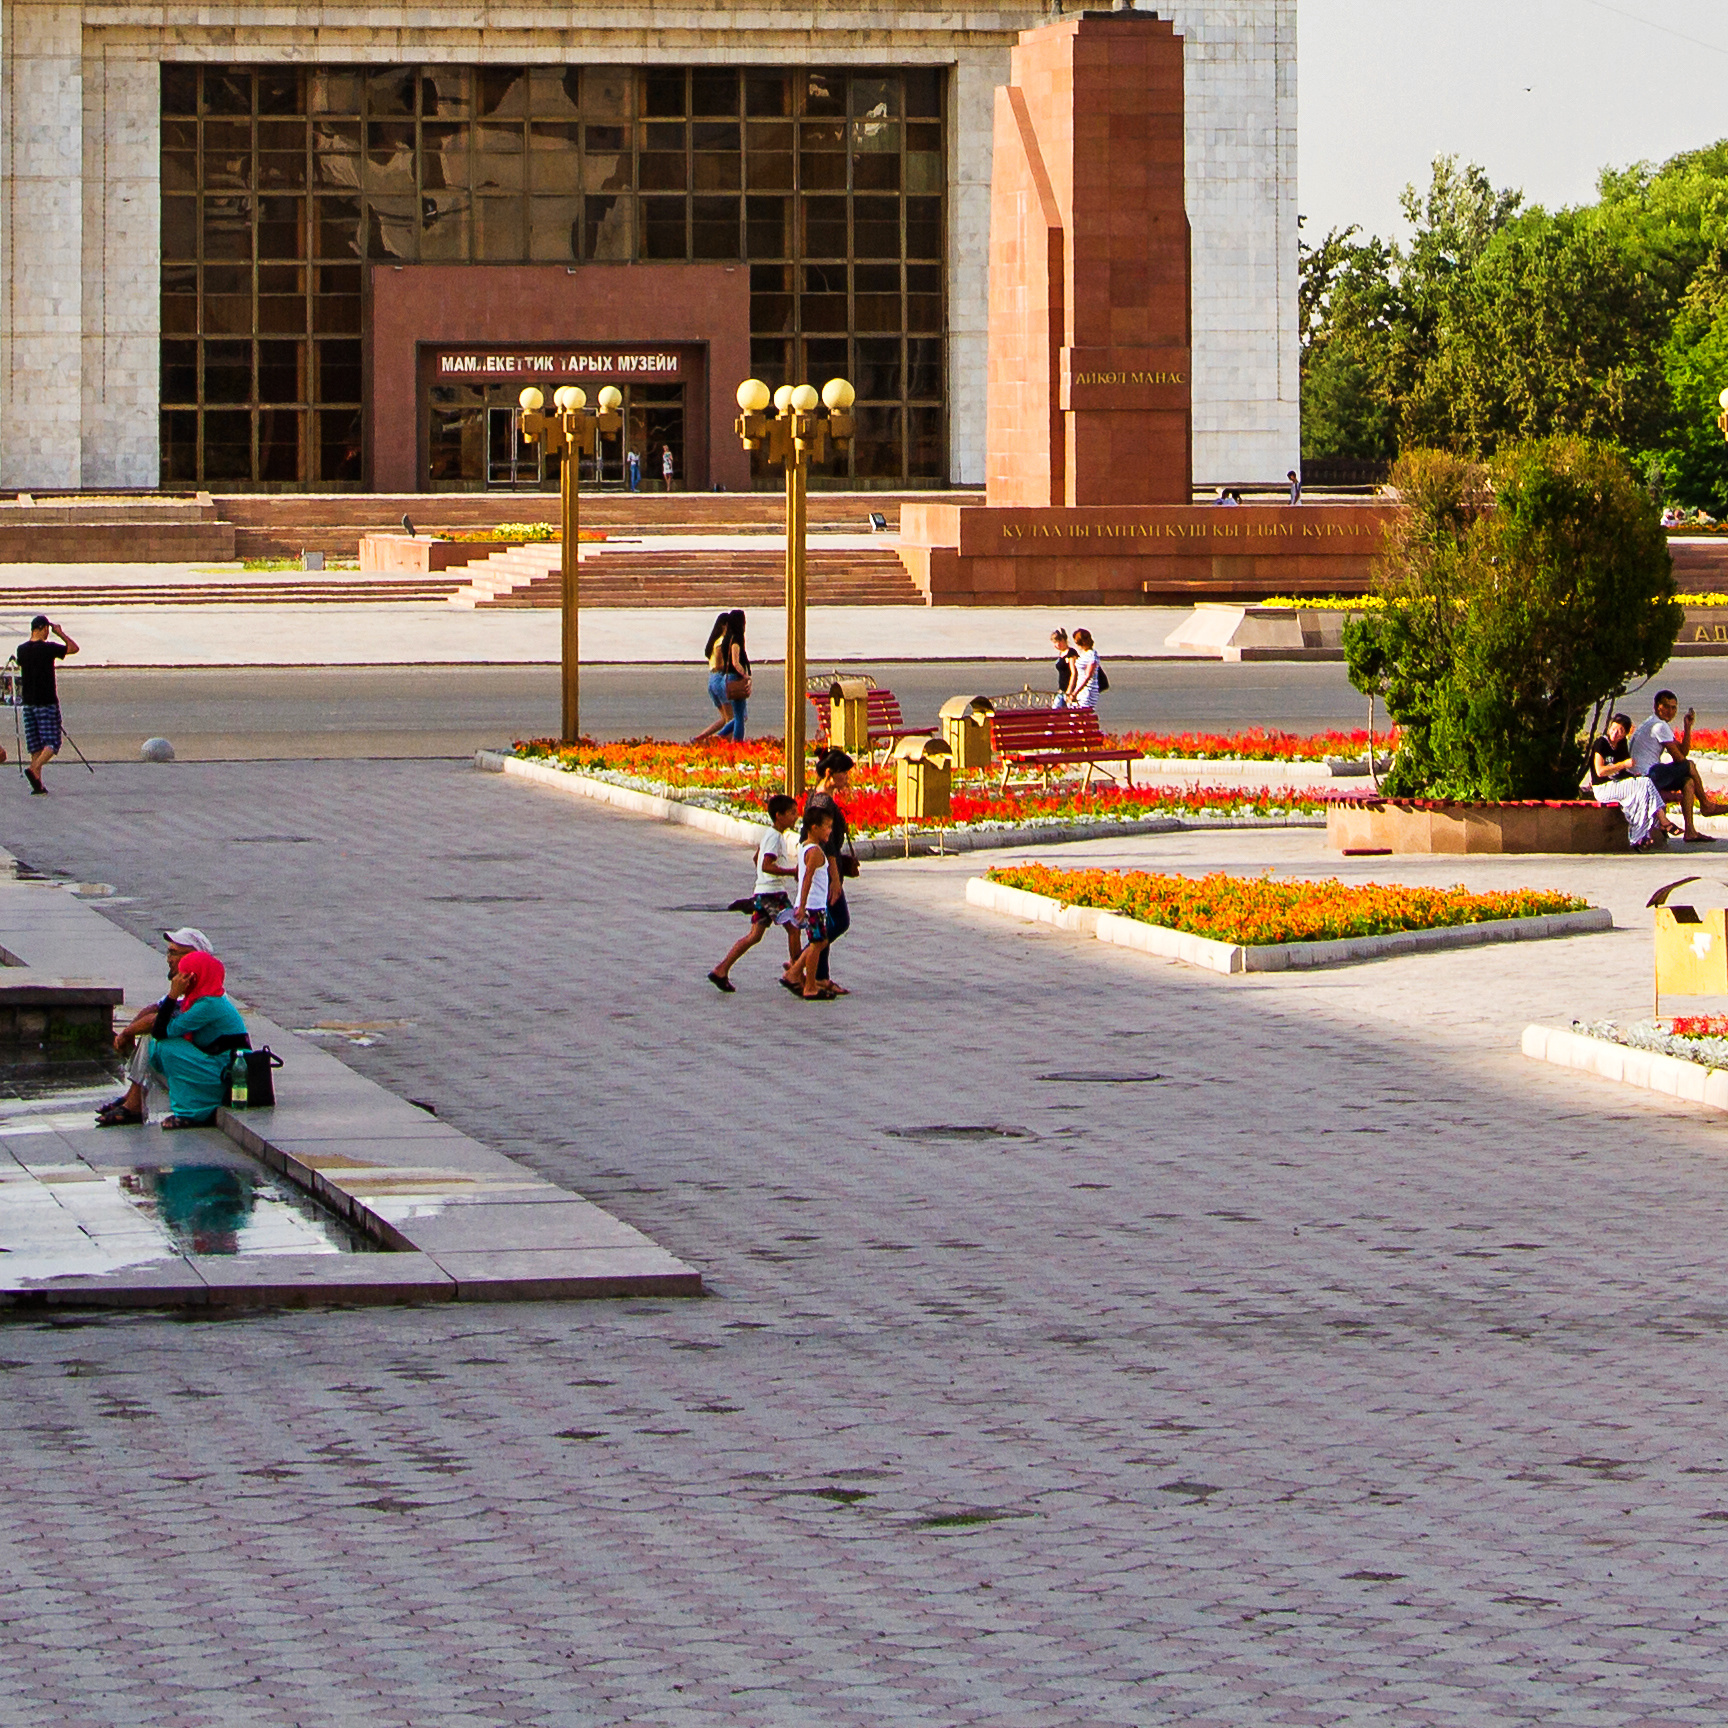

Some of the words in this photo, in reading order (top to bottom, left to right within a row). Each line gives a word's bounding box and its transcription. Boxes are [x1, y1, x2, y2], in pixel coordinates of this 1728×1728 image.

[441, 356, 554, 372] МАМЛЕКЕТТИК
[559, 355, 613, 372] ТАРЫХ
[617, 353, 678, 372] МУЗЕЙИ
[1075, 371, 1126, 385] АЙКӨЛ
[1131, 372, 1187, 385] МАНАС
[1165, 524, 1207, 538] КУШ
[1302, 524, 1372, 540] КУРАМА
